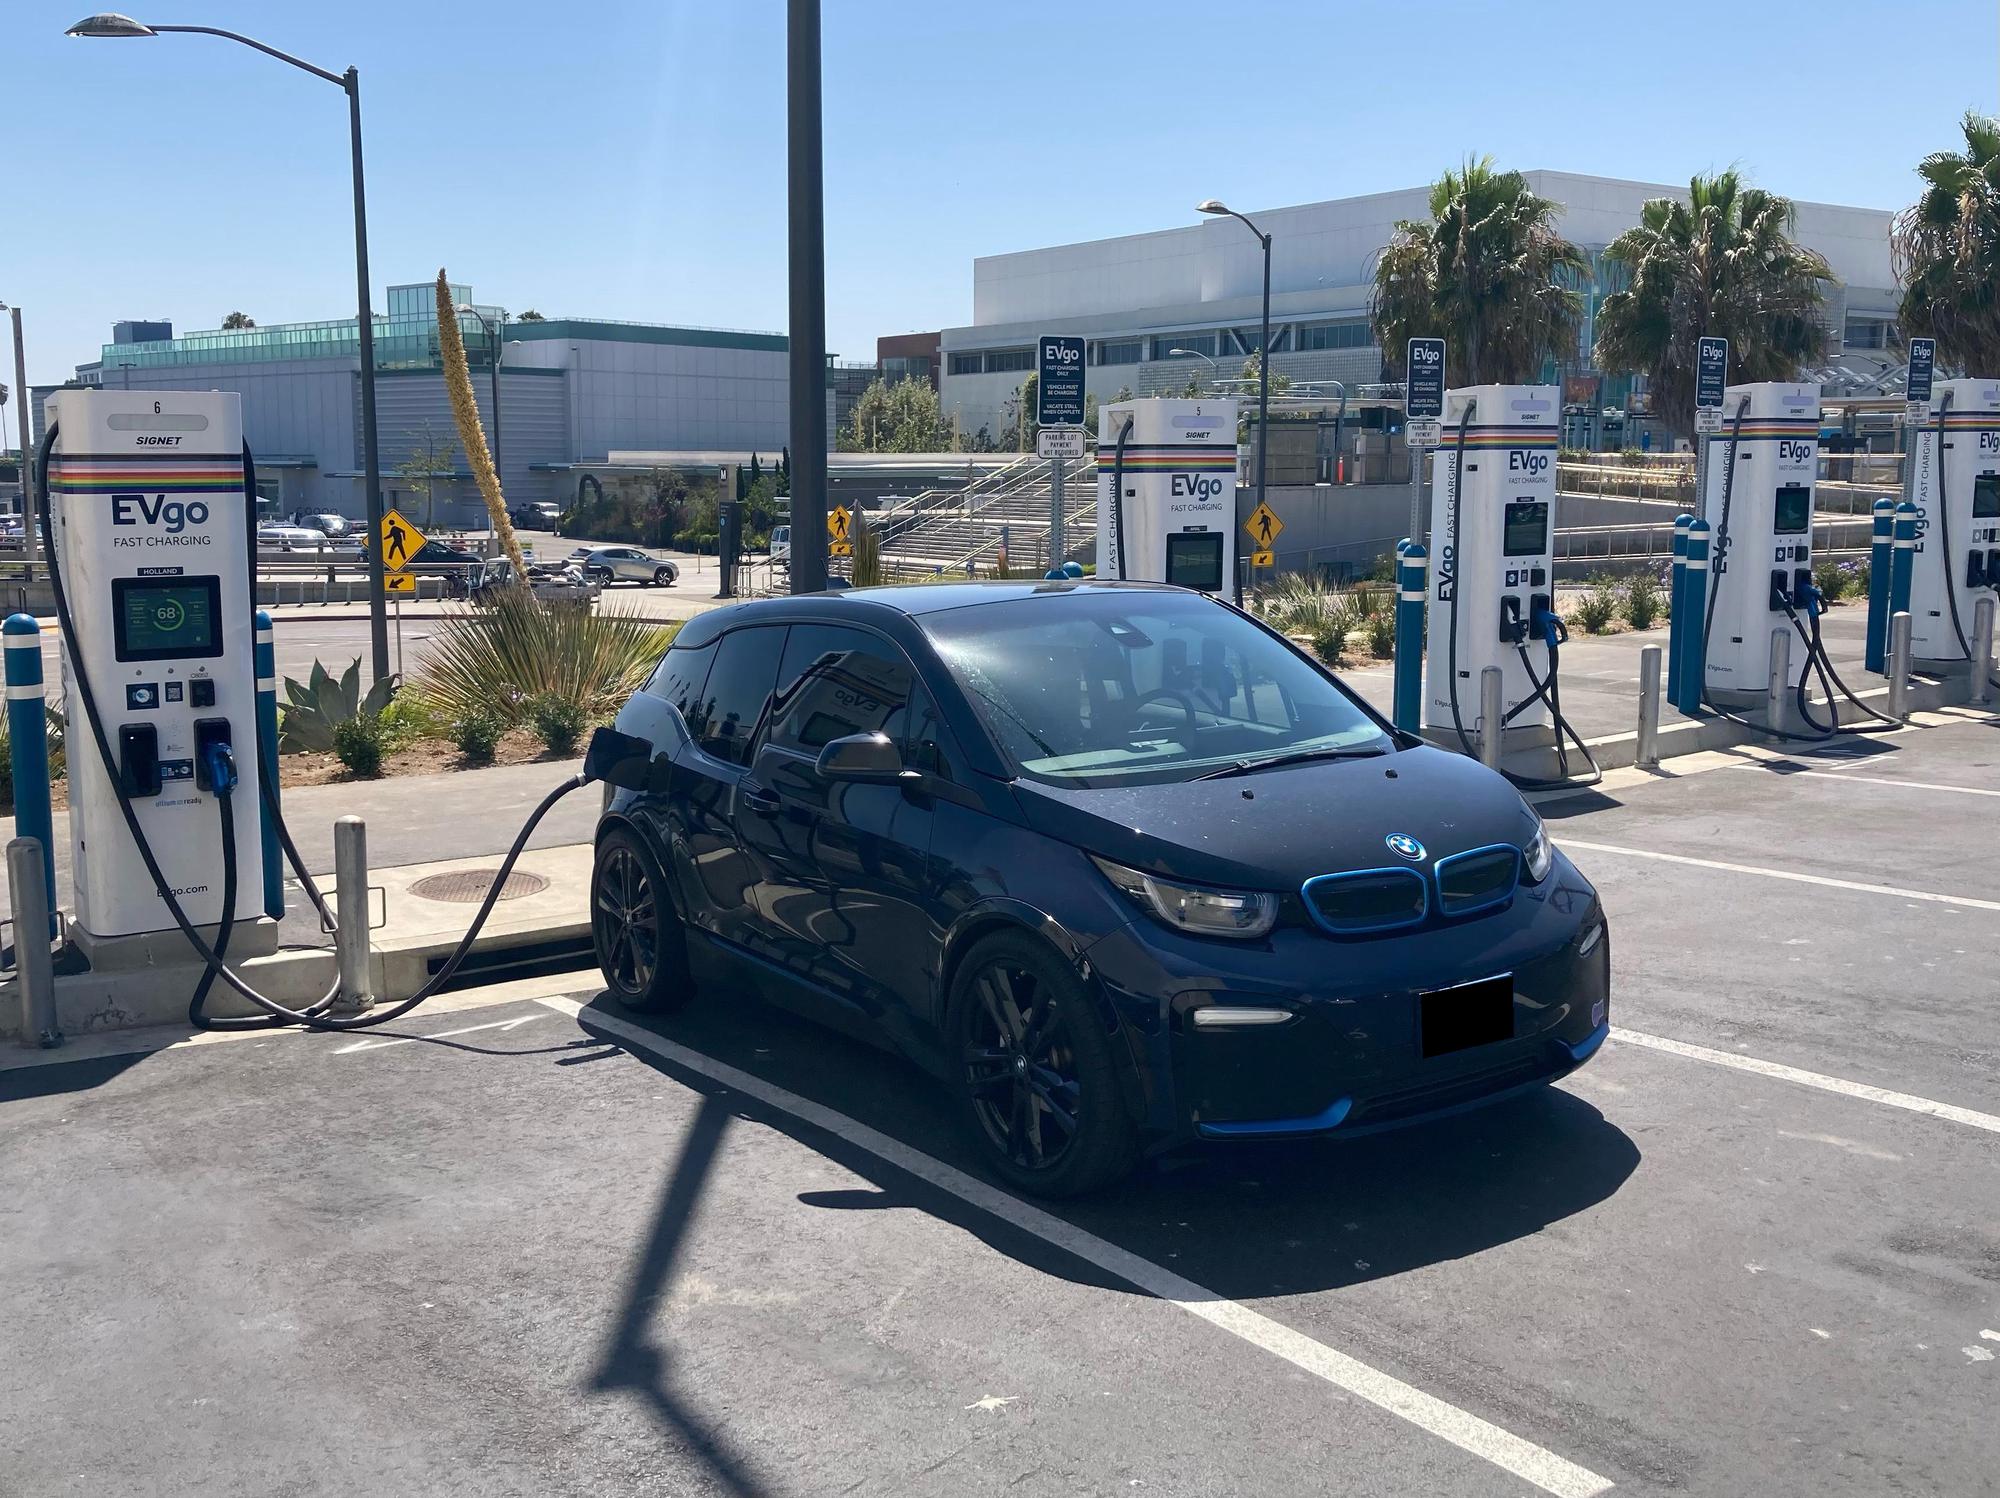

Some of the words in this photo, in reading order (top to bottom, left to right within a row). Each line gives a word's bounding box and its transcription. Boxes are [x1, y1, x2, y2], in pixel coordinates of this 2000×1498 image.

[1046, 346, 1079, 364] EVgo
[1414, 348, 1439, 363] EVgo
[1703, 346, 1723, 360] EVgo
[1913, 346, 1931, 358] EVgo
[154, 401, 160, 414] 6
[1196, 406, 1201, 416] 5
[136, 436, 182, 445] SIGNET
[1980, 433, 2000, 452] EVg
[1780, 441, 1810, 463] EVgo
[1510, 450, 1548, 475] EVgo
[1172, 474, 1222, 502] EVgo
[1914, 508, 1929, 553] EVgo
[1922, 433, 1931, 479] CHARGING
[112, 494, 208, 533] EVgo
[1188, 503, 1222, 511] CHARGING
[114, 537, 143, 547] FAST
[146, 536, 210, 546] CHARGING
[158, 607, 176, 619] 68
[157, 885, 208, 898] Ego.com
